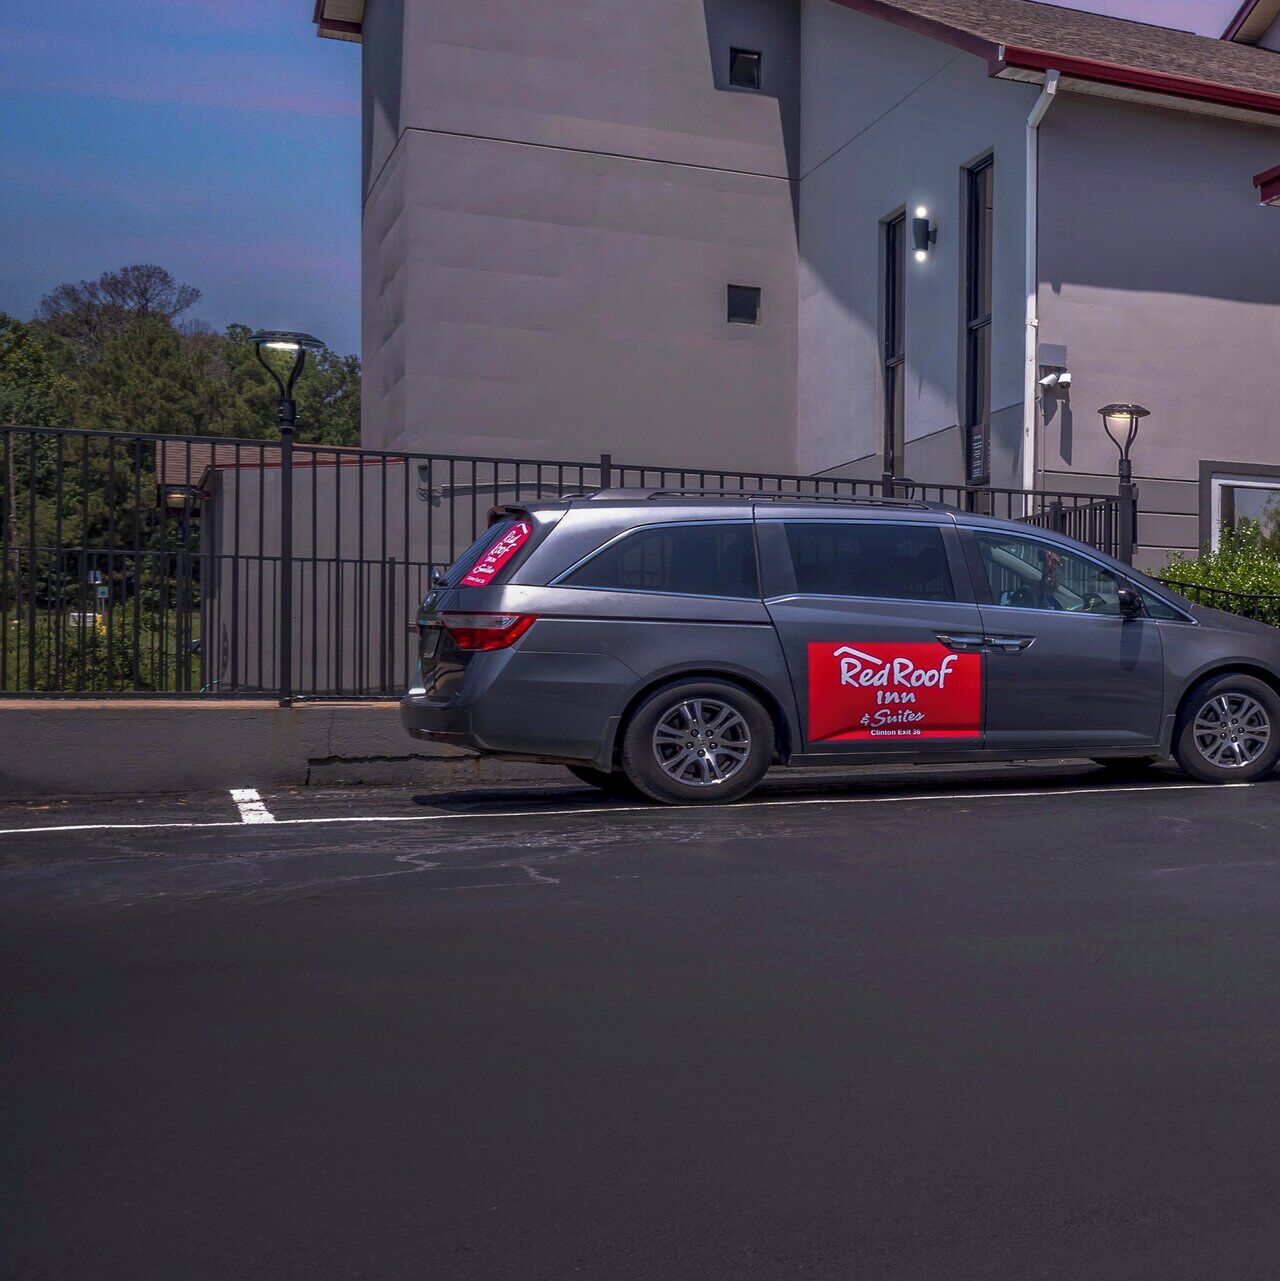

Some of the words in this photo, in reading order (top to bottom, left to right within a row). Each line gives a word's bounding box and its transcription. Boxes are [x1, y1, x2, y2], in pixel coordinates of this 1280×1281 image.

[860, 713, 870, 726] &
[870, 708, 925, 728] Suites
[897, 728, 911, 736] Exit
[912, 728, 921, 736] 36
